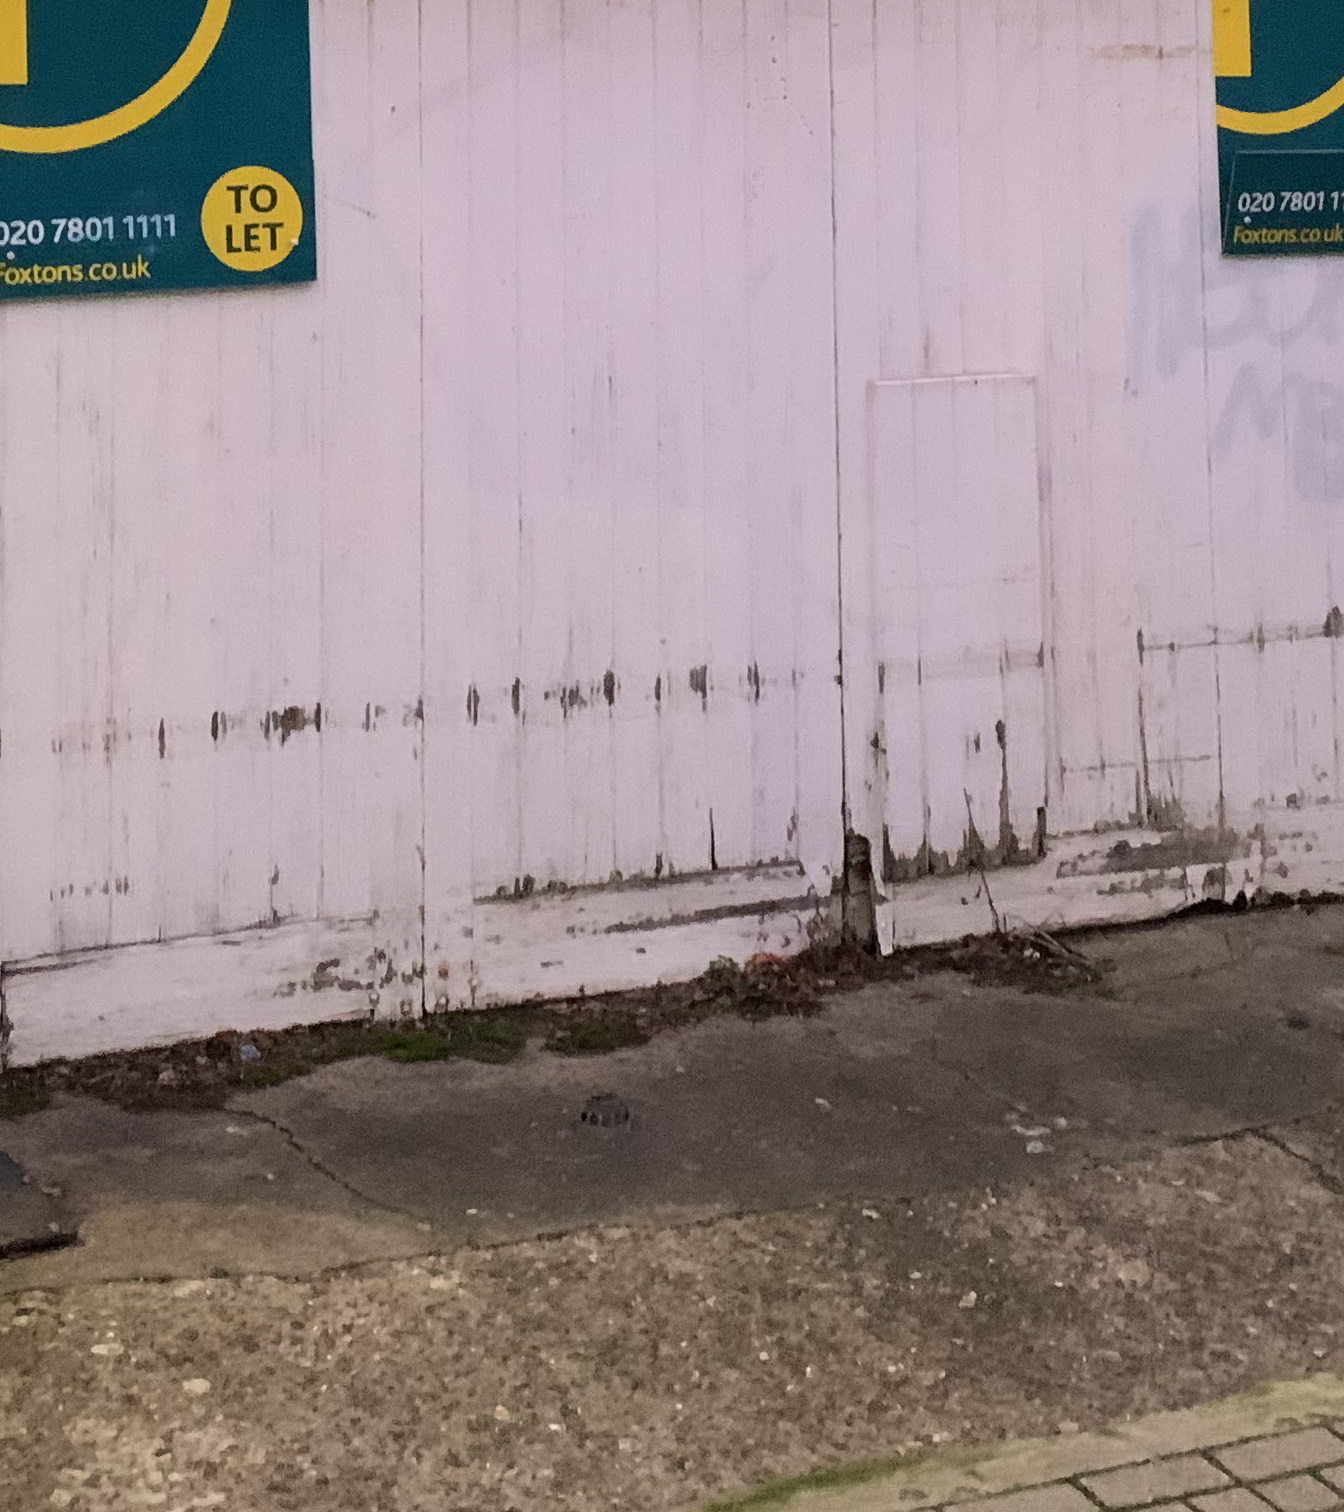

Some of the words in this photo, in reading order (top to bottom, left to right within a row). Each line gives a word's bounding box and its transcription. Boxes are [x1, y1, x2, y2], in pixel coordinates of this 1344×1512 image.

[226, 183, 278, 214] TO
[1237, 191, 1275, 213] 020
[1279, 190, 1325, 212] 7801
[50, 215, 114, 244] 7801
[122, 213, 176, 240] 1111
[225, 222, 284, 254] LET
